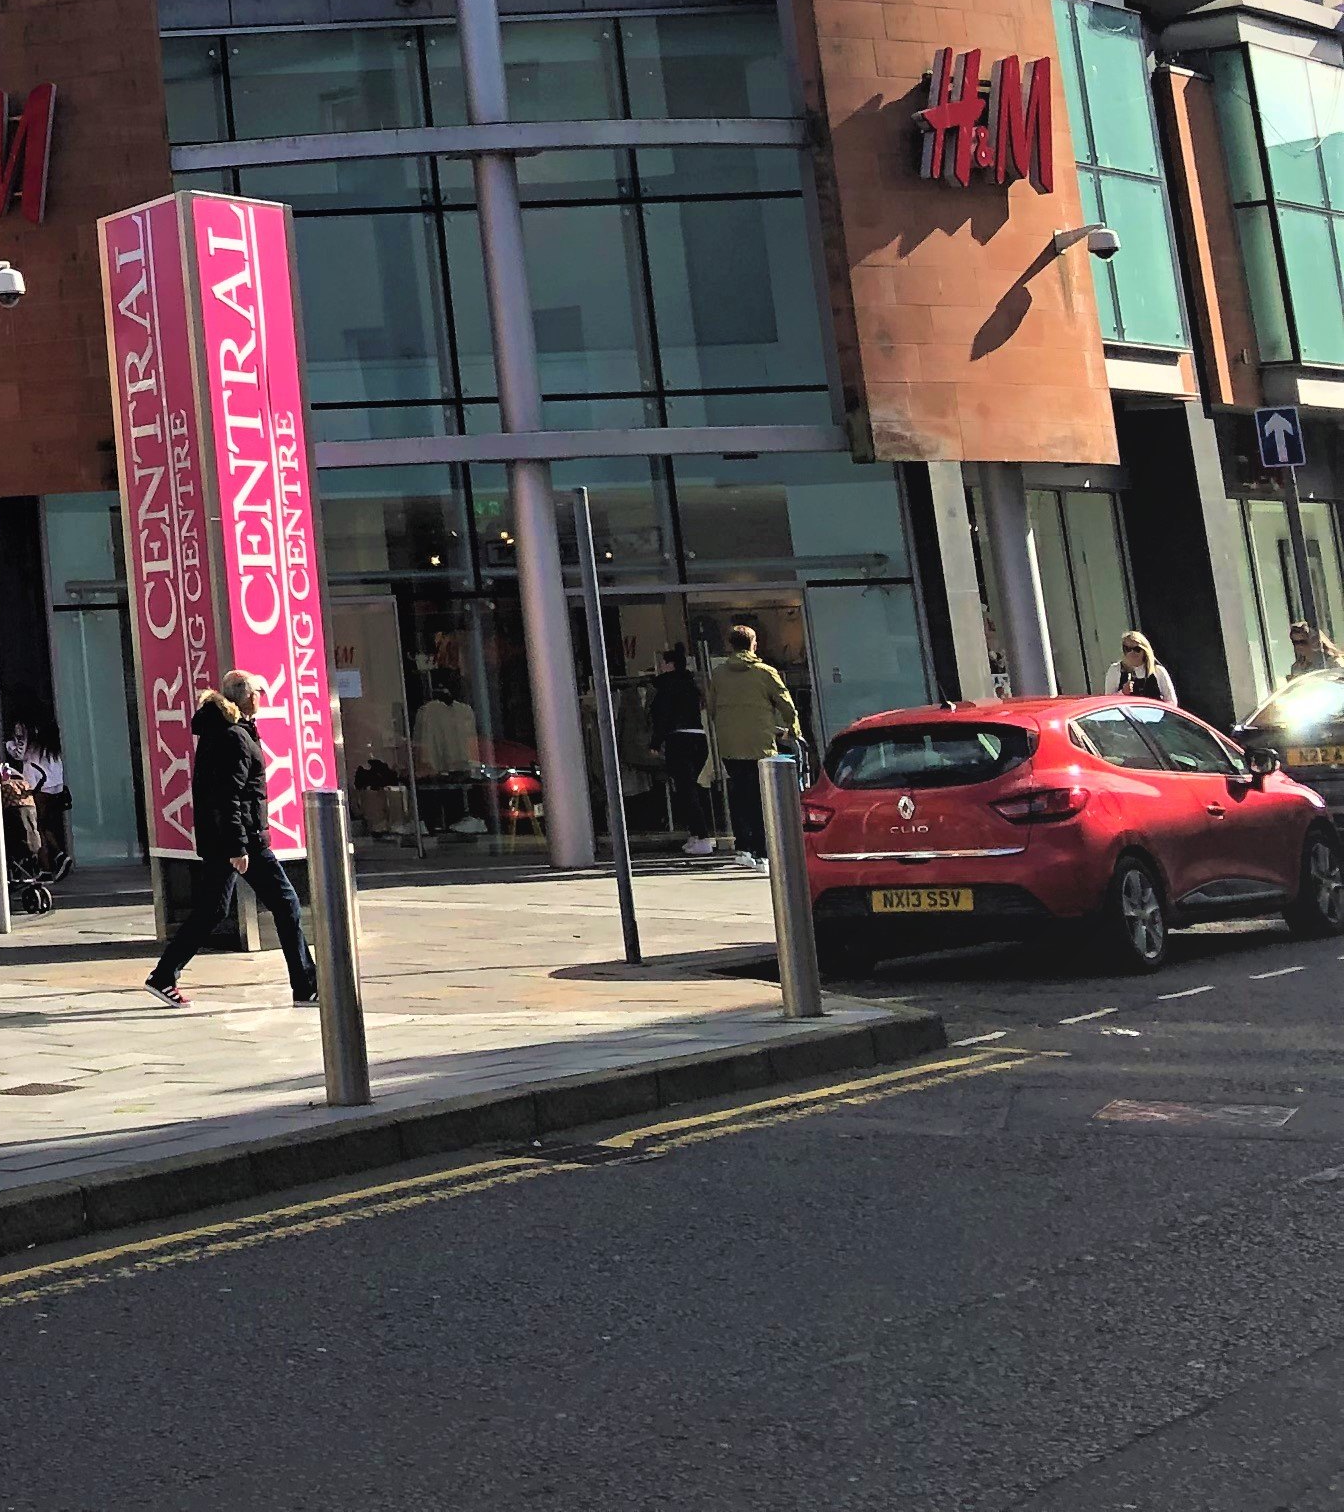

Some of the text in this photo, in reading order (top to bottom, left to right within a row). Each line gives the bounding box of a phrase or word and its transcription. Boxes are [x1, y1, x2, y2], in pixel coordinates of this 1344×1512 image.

[912, 46, 1054, 195] H&M
[171, 408, 202, 602] CENTRE
[208, 203, 280, 635] CENTRAL
[115, 214, 197, 850] AYR CENTRAL
[274, 410, 327, 788] OPPING CENTRE
[882, 890, 961, 908] NX13 SSV
[890, 825, 929, 834] CLIO
